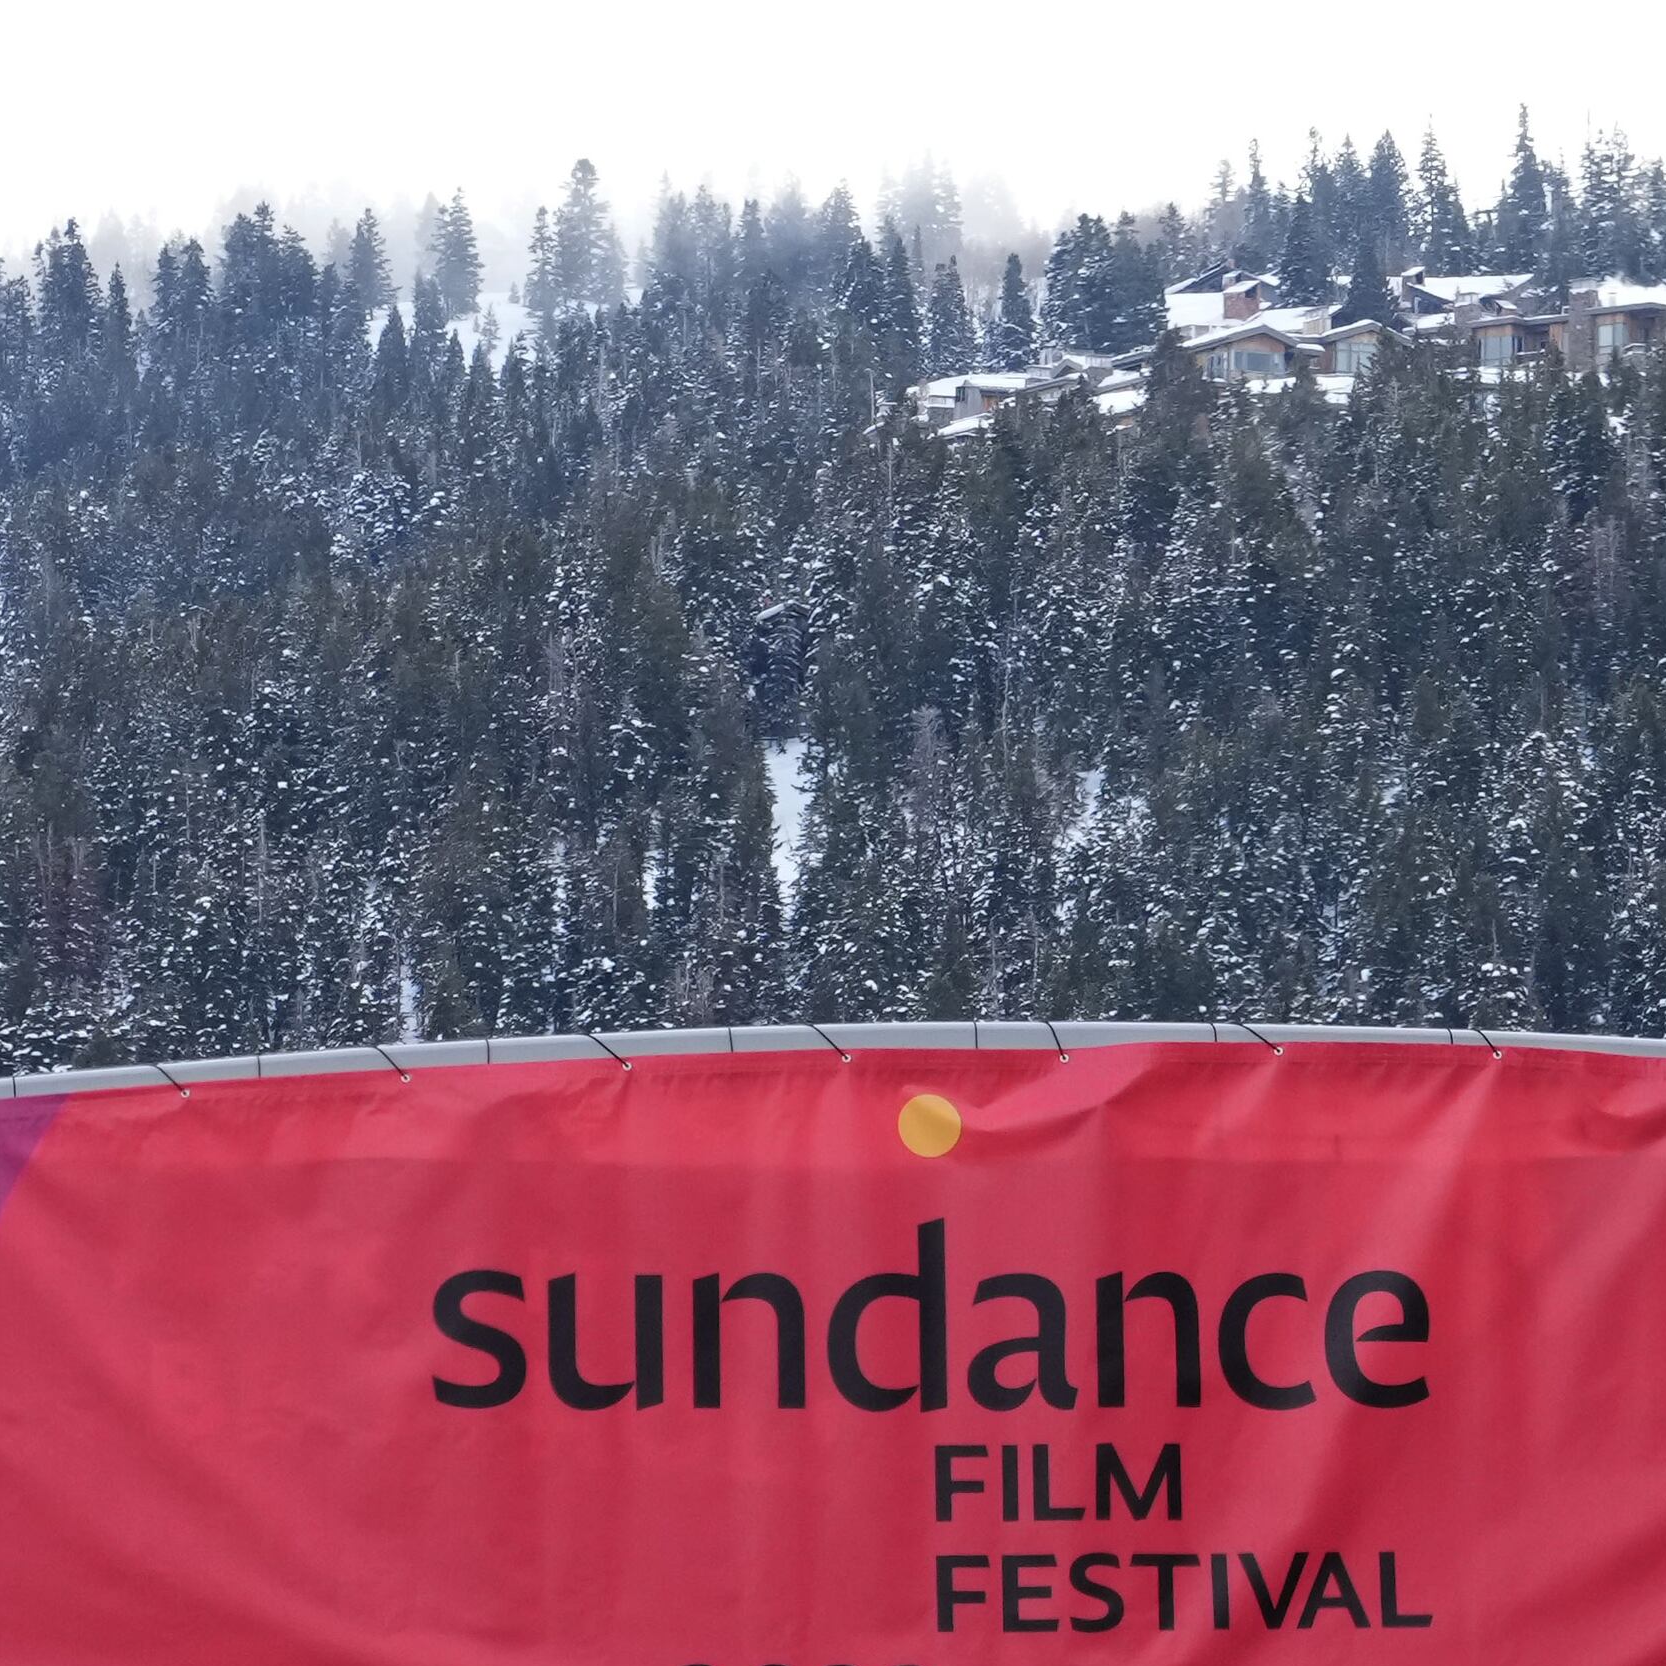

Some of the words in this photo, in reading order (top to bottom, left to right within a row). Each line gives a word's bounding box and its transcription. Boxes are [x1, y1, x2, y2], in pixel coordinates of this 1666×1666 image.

[431, 1218, 1430, 1410] sundance
[935, 1443, 1182, 1521] FILM
[935, 1552, 1432, 1631] FESTIVAL
